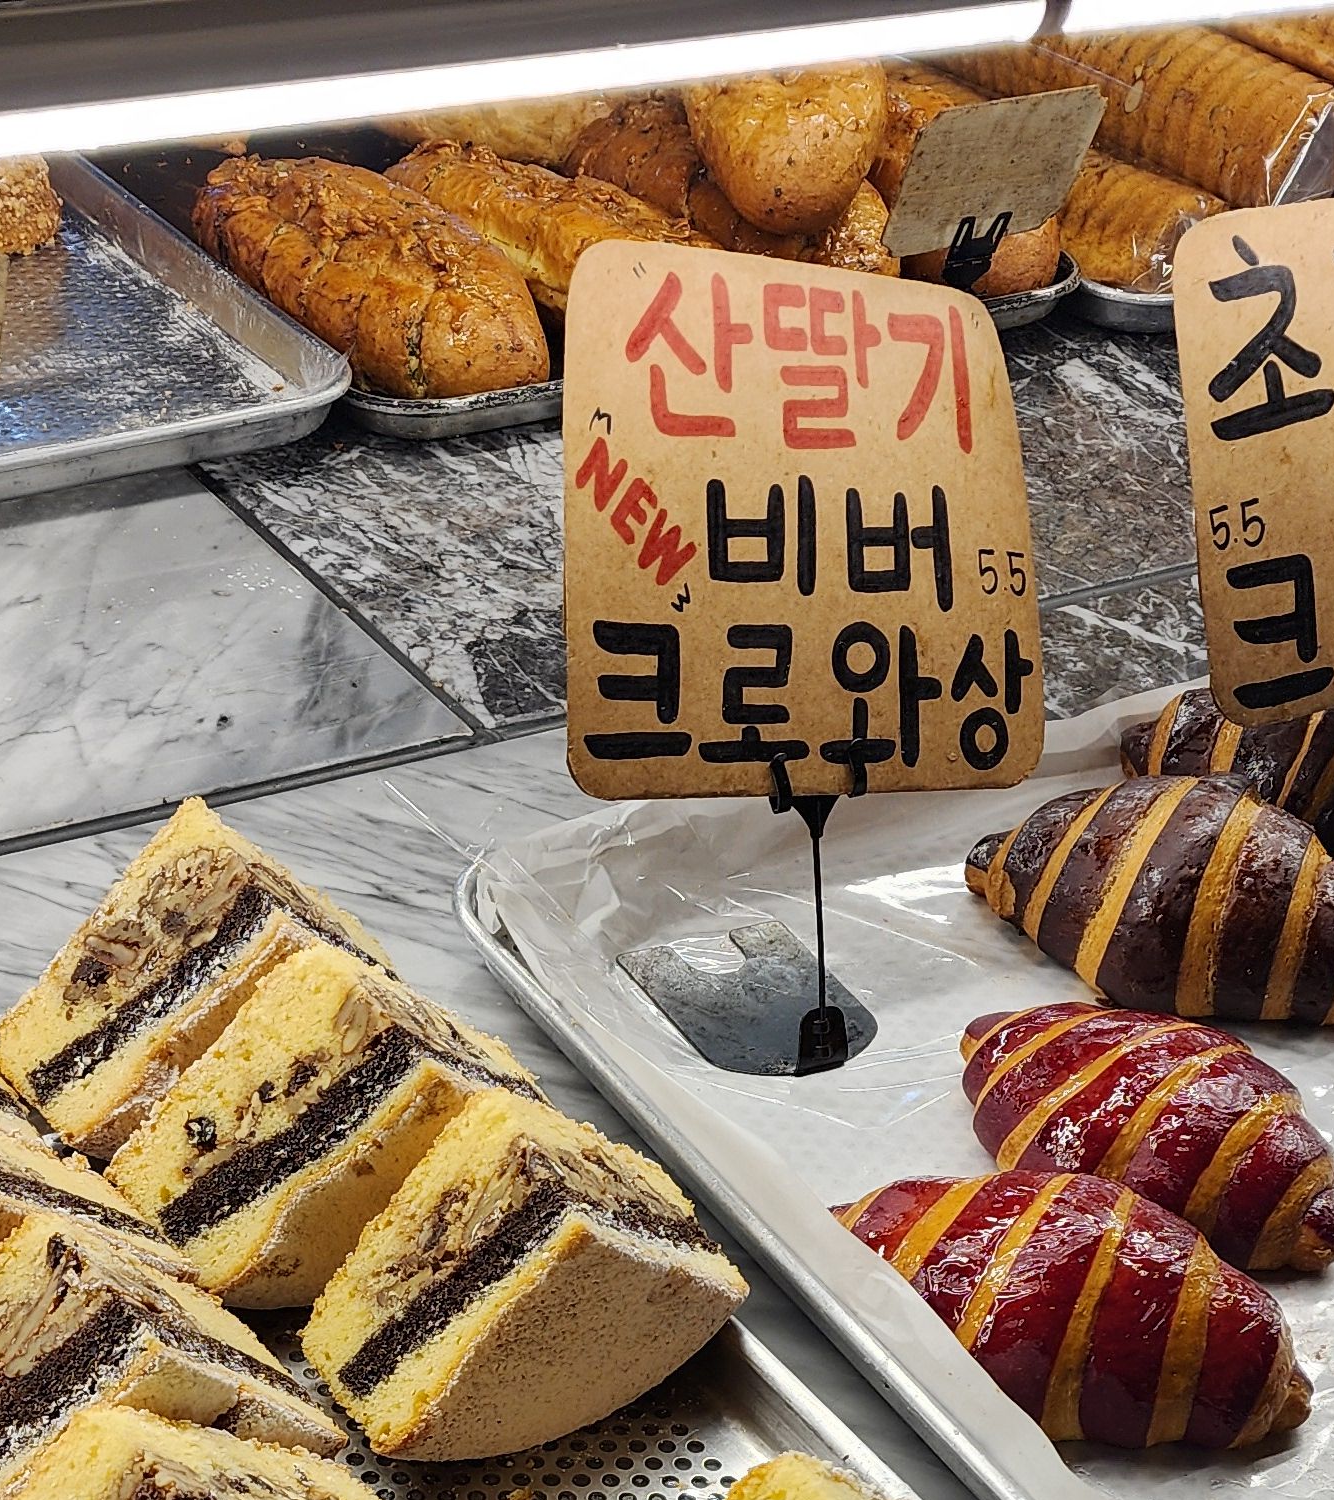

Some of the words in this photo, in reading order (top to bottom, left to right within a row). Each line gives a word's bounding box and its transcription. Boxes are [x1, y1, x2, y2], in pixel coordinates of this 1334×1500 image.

[625, 270, 973, 454] 산딸기
[575, 436, 698, 587] NEW
[705, 474, 954, 612] 비버
[977, 548, 1027, 598] 5.5
[1208, 497, 1267, 551] 5.5
[583, 620, 1035, 772] 크로와상
